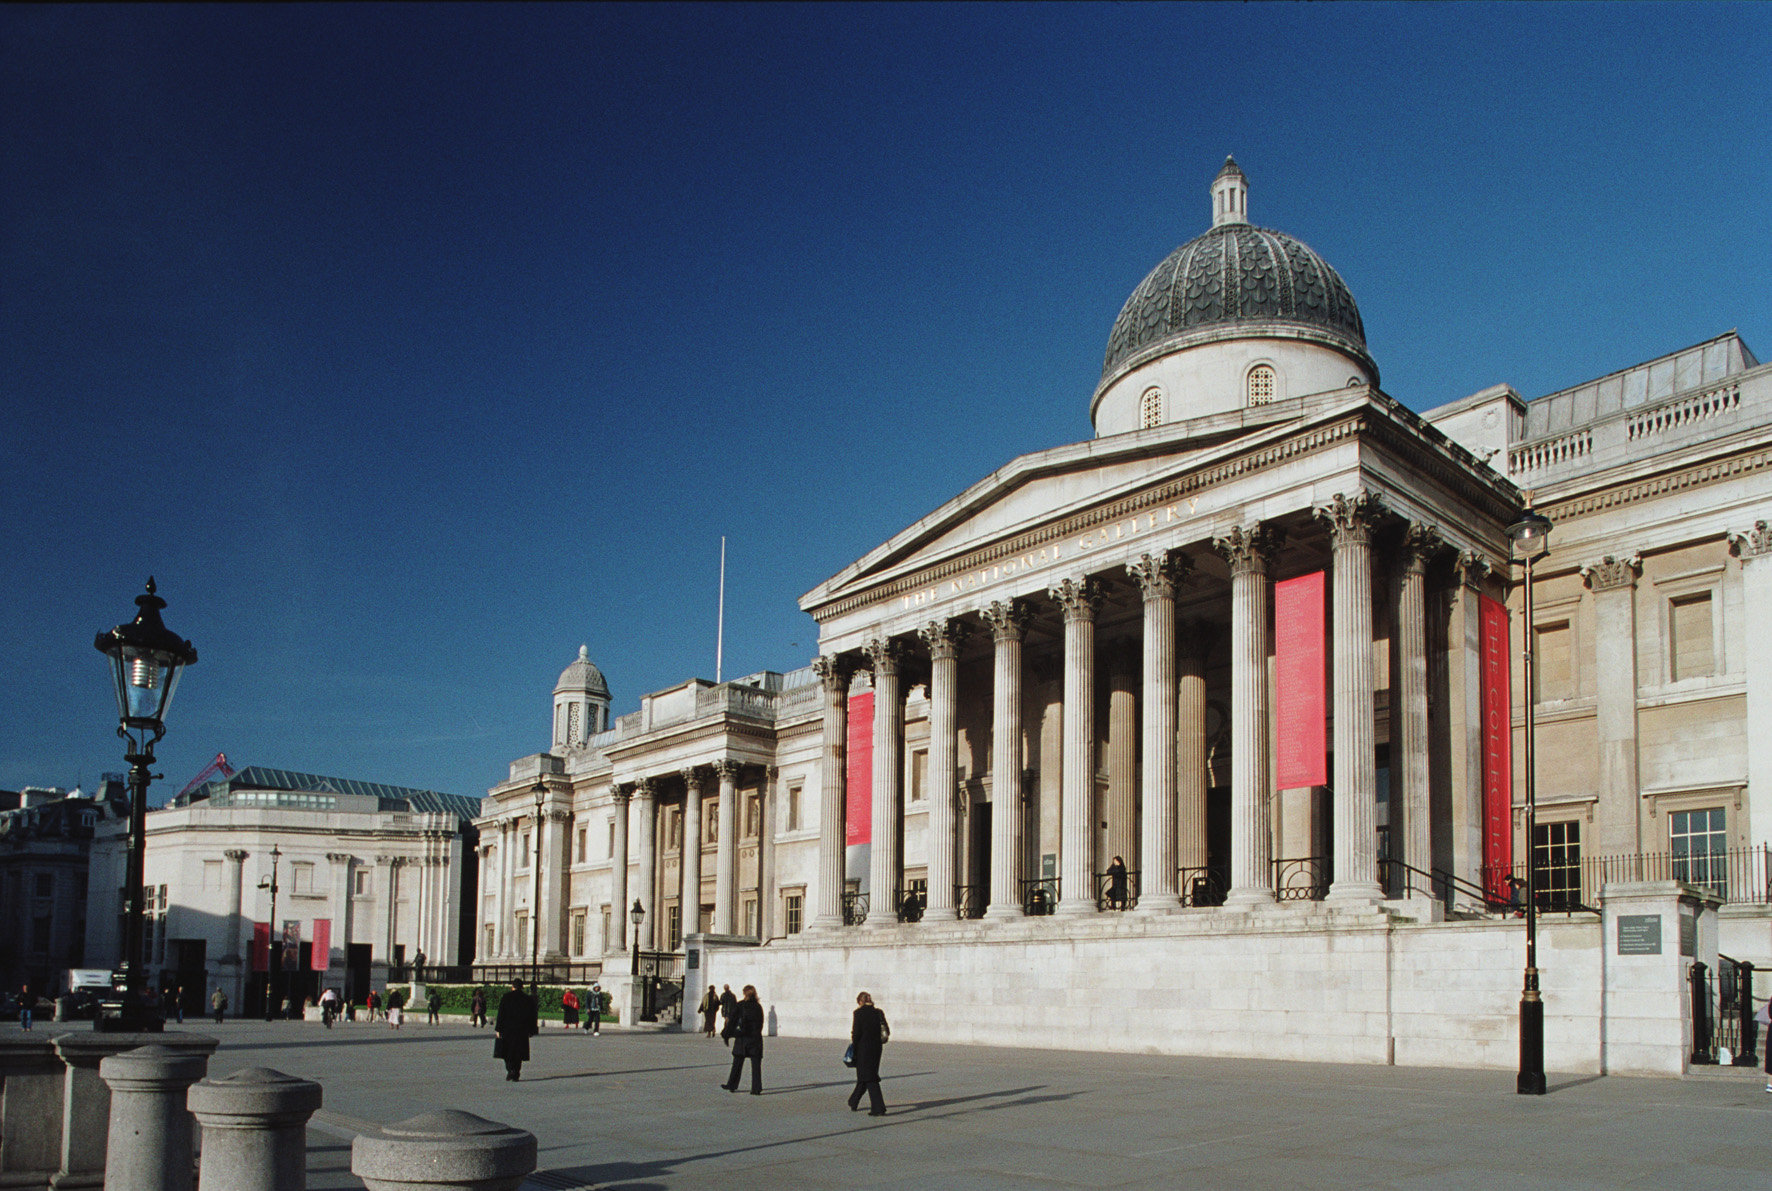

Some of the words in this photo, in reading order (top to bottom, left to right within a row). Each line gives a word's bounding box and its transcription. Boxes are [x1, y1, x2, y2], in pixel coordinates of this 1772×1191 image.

[901, 586, 938, 610] THE
[951, 543, 1063, 594] NATIONAL
[1079, 496, 1200, 550] GALLERY
[1489, 615, 1499, 674] THE
[1489, 687, 1501, 887] COLLECTION
